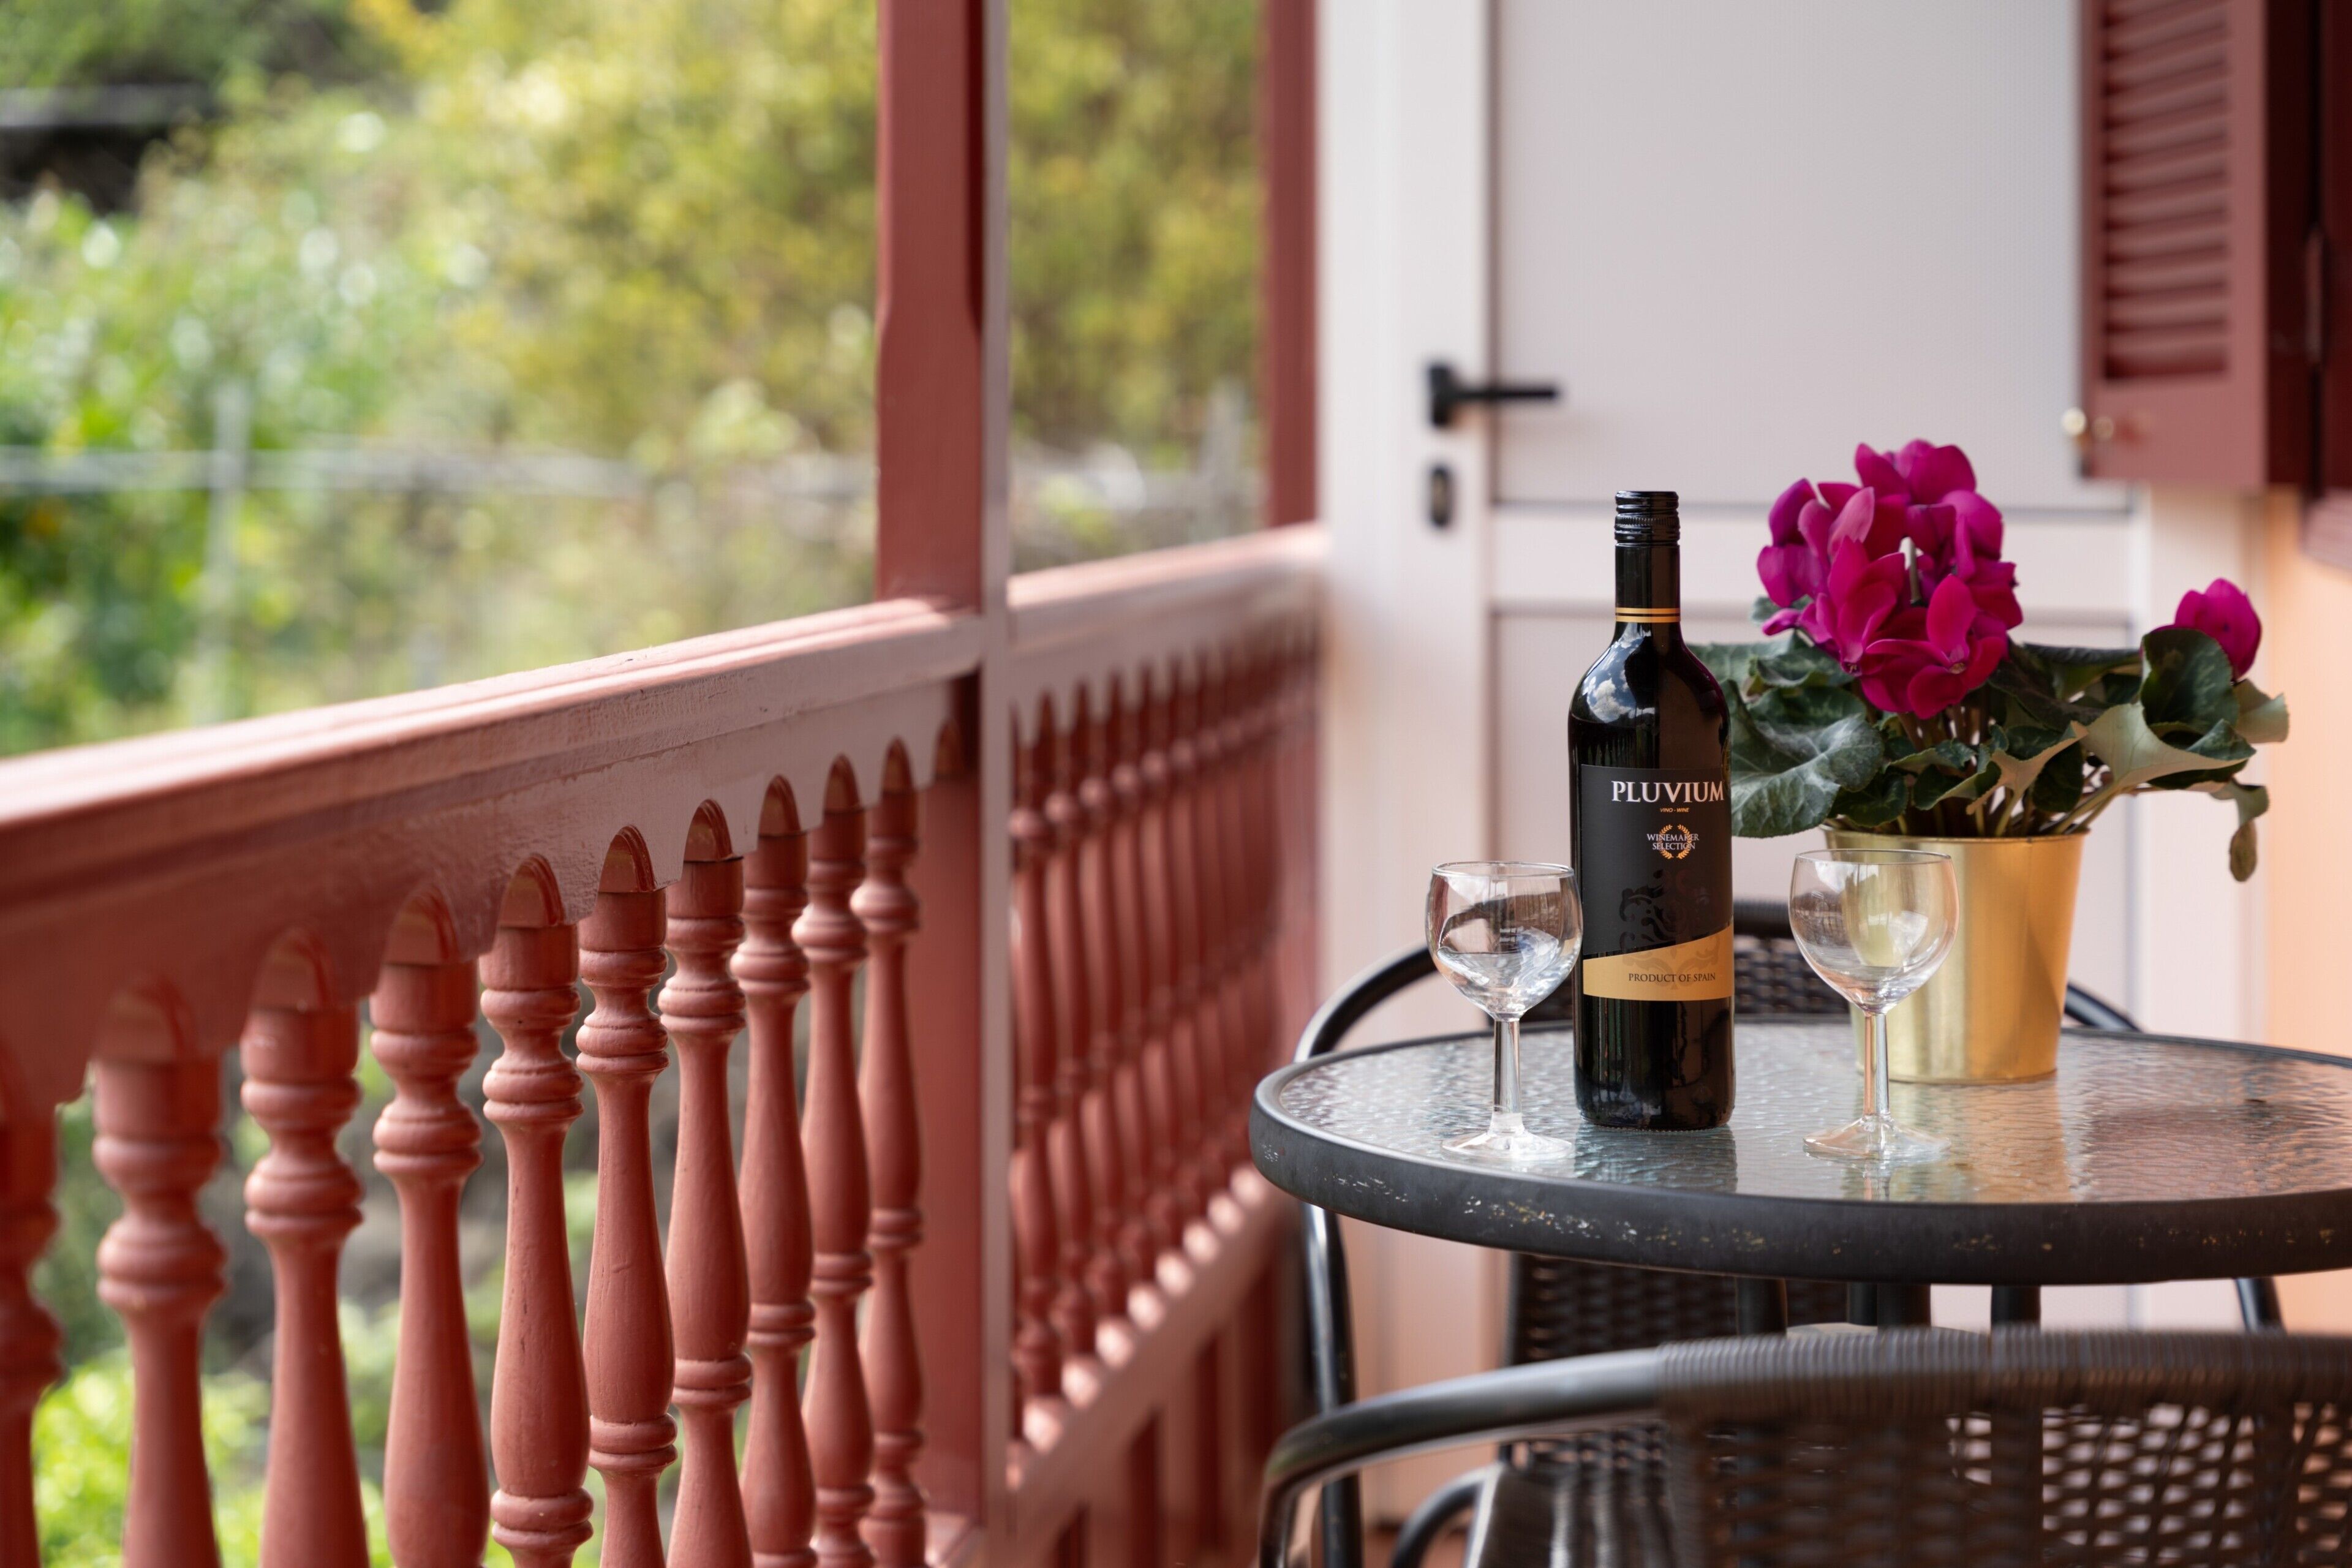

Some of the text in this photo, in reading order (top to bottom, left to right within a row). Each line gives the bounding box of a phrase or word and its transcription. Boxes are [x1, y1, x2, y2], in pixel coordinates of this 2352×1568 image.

[1611, 780, 1724, 803] PLUVIUM
[1646, 833, 1700, 842] WINEMAKER
[1652, 842, 1696, 851] SELECTION
[1628, 972, 1716, 983] PRODUCT OF SPAIN
